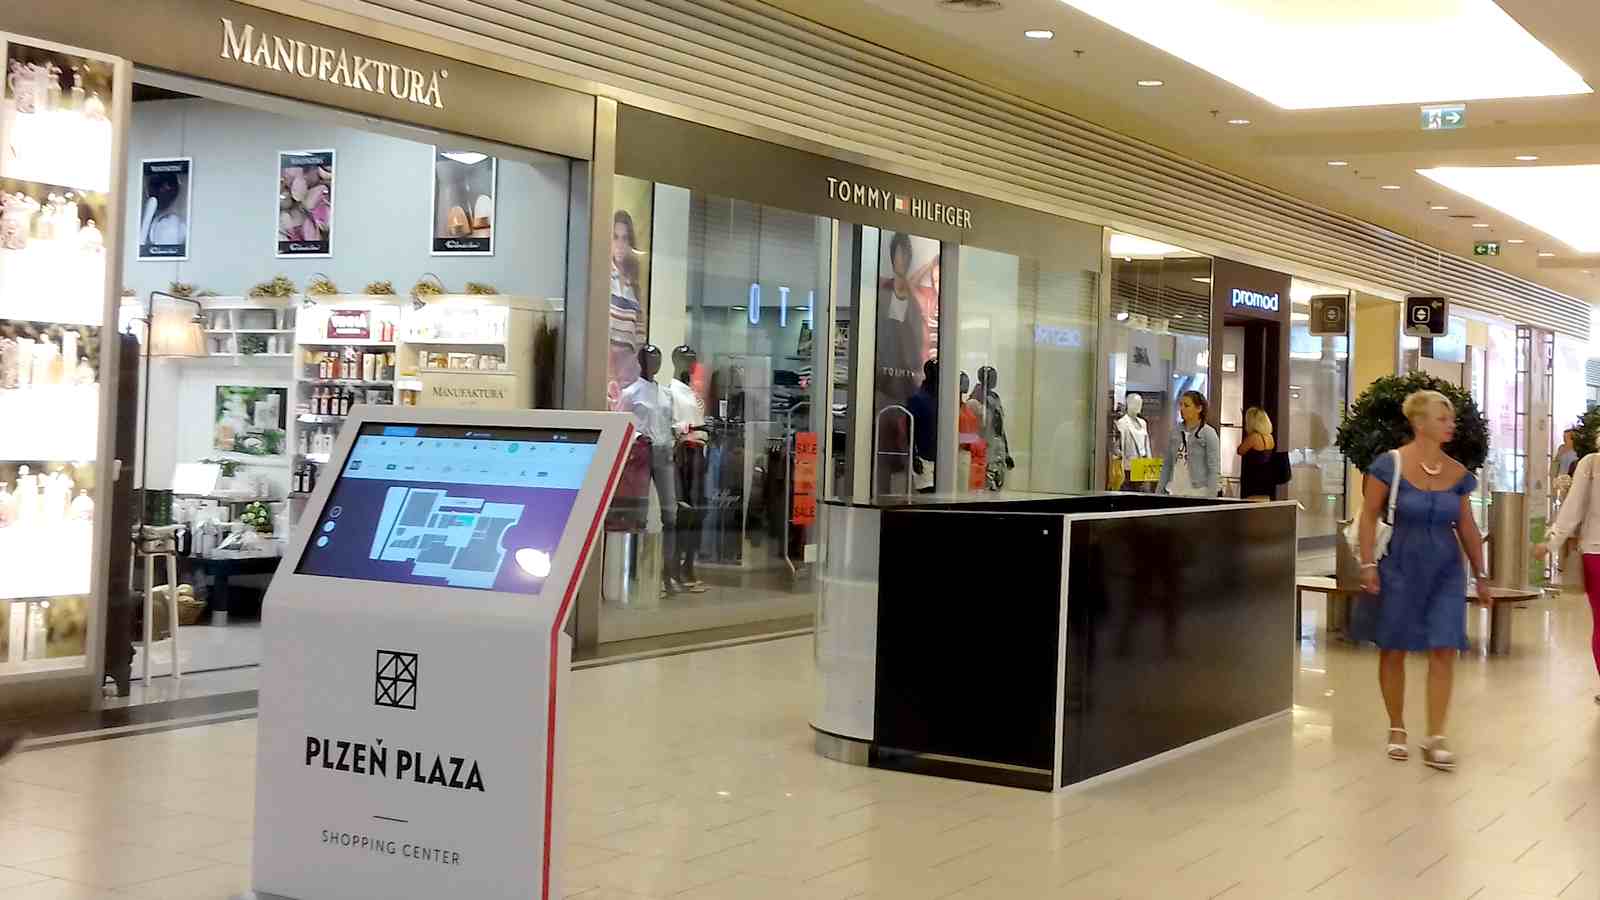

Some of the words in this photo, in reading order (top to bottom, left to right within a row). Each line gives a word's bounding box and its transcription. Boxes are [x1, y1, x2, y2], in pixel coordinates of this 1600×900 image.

[219, 17, 445, 109] MANUFAKTURA
[827, 177, 891, 211] TOMMY
[912, 198, 972, 229] HILFIGER
[1232, 288, 1279, 311] promod
[432, 386, 505, 399] MANUFAKTURA
[305, 736, 387, 778] PLZEŇ
[396, 749, 486, 793] PLAZA
[321, 829, 397, 855] SHOPPING
[402, 844, 462, 866] CENTER
